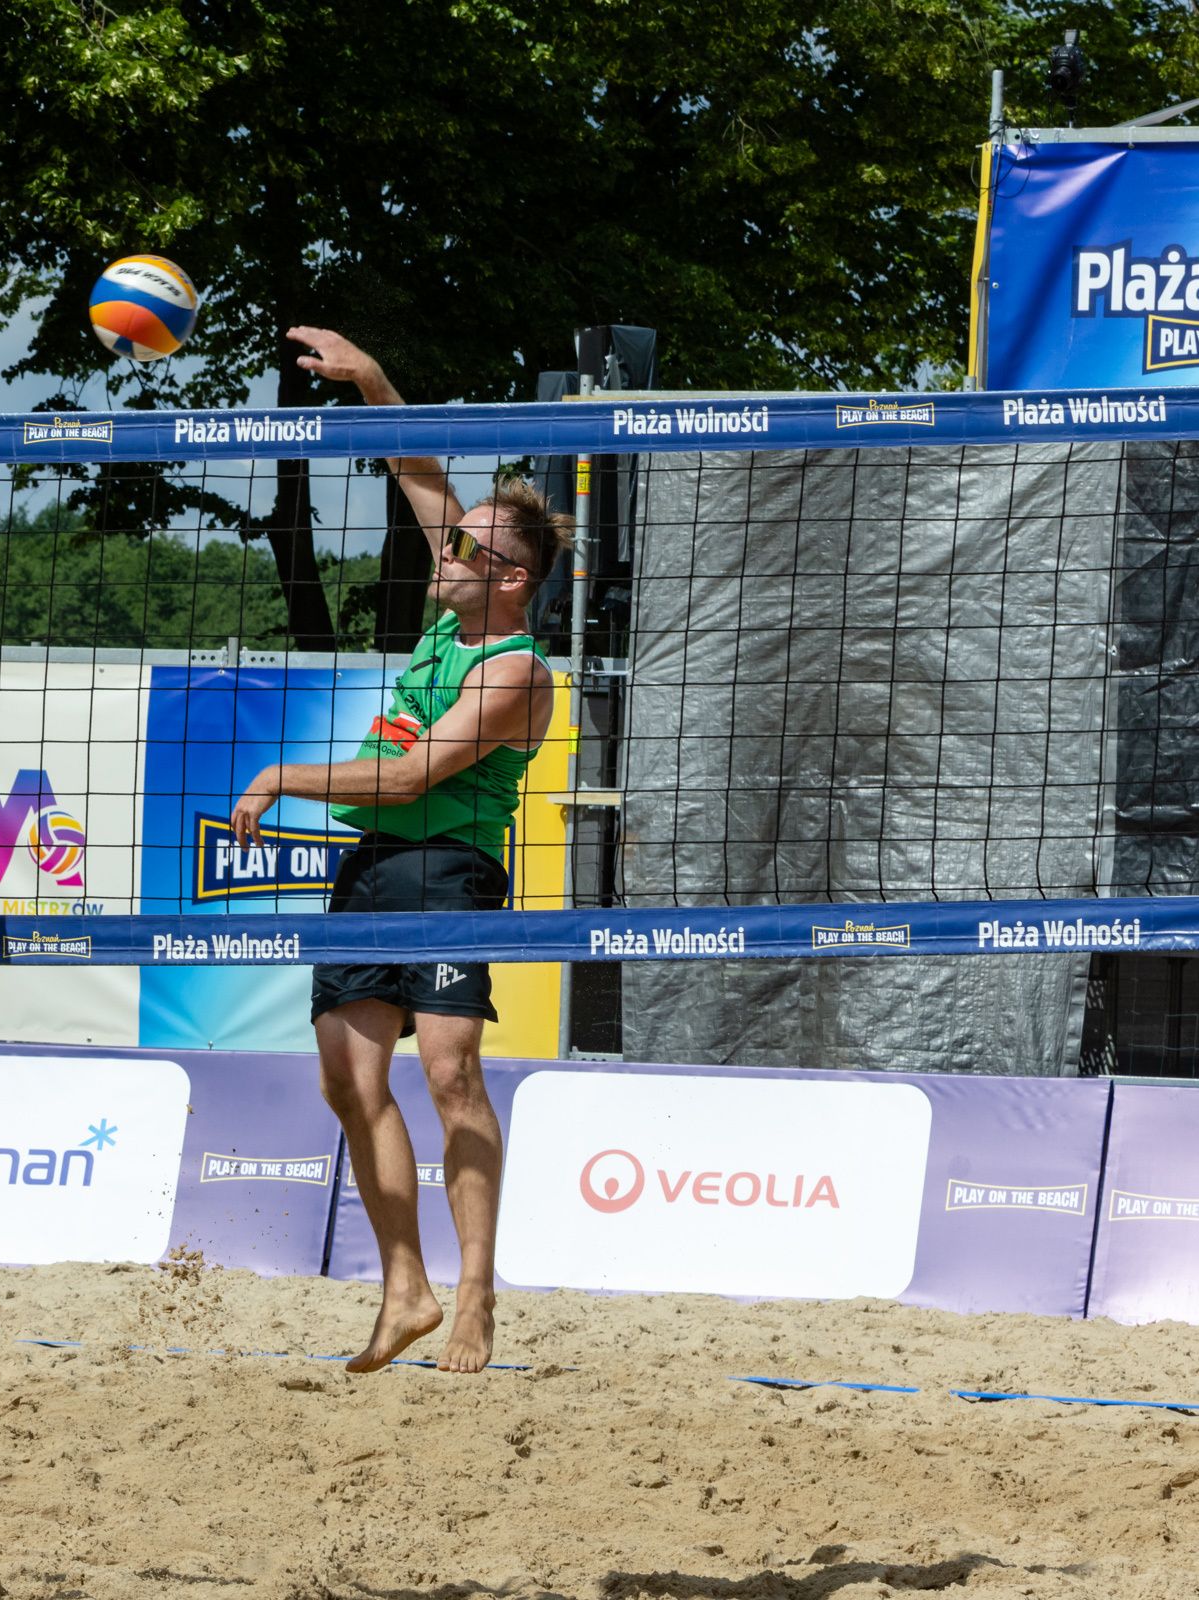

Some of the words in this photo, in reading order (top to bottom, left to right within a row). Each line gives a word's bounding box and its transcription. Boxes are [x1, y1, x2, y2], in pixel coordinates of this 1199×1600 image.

[1160, 327, 1199, 357] PLA
[613, 408, 672, 435] Plaża
[675, 405, 769, 434] Wolności
[841, 408, 863, 423] PLAY
[865, 410, 880, 422] ON
[881, 410, 898, 422] THE
[900, 408, 930, 422] BEACH
[1003, 397, 1065, 426] Plaża
[1067, 395, 1167, 424] Wolności
[28, 426, 48, 440] PLAY
[50, 428, 63, 438] ON
[65, 428, 80, 438] THE
[81, 426, 108, 439] BEACH
[174, 417, 230, 443] Plaża
[233, 415, 322, 442] Wolności
[215, 838, 281, 880] PLAY
[290, 847, 327, 877] ON
[3, 898, 104, 914] MISTRZÓW
[590, 927, 648, 955] Plaża
[652, 926, 745, 954] Wolności
[818, 931, 839, 944] PLAY
[842, 932, 855, 943] ON
[857, 932, 873, 943] THE
[875, 930, 905, 943] BEACH
[978, 920, 1039, 948] Plaża
[1043, 918, 1140, 946] Wolności
[8, 942, 27, 953] PLAY
[29, 943, 42, 952] ON
[43, 943, 59, 952] THE
[60, 942, 87, 953] BEACH
[153, 933, 208, 959] Plaża
[212, 932, 300, 959] Wolności
[208, 1159, 238, 1177] PLAY
[240, 1162, 257, 1175] ON
[261, 1163, 282, 1176] THE
[285, 1161, 323, 1178] BEACH
[417, 1168, 432, 1181] HE
[657, 1169, 840, 1208] VEOLIA
[954, 1187, 985, 1203] PLAY
[989, 1191, 1007, 1203] ON
[1011, 1192, 1033, 1204] THE
[1038, 1191, 1079, 1208] BEACH
[1117, 1197, 1150, 1214] PLAY
[1153, 1202, 1171, 1215] ON
[1176, 1203, 1199, 1216] THE
